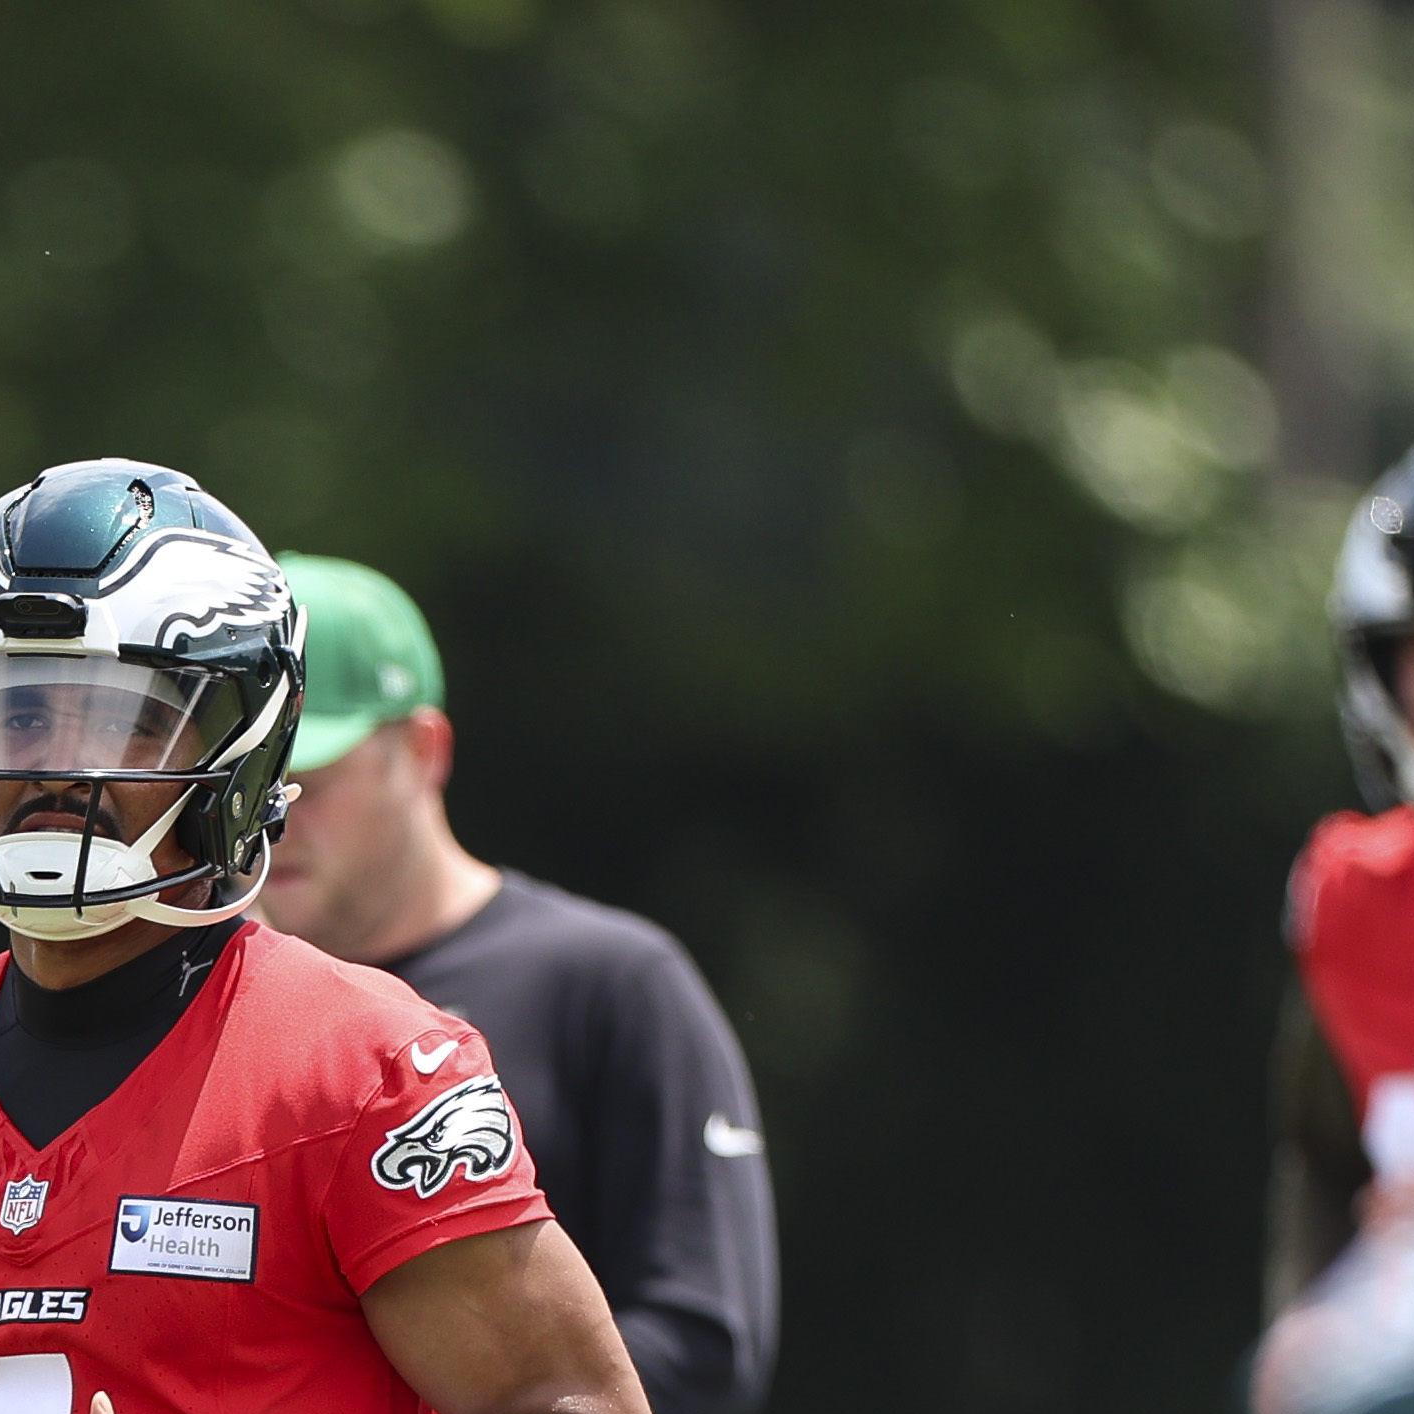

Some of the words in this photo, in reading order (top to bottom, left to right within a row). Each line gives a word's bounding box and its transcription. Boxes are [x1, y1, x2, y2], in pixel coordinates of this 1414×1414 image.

[6, 1201, 34, 1222] NFL
[154, 1207, 251, 1232] Jefferson
[150, 1235, 220, 1257] Health
